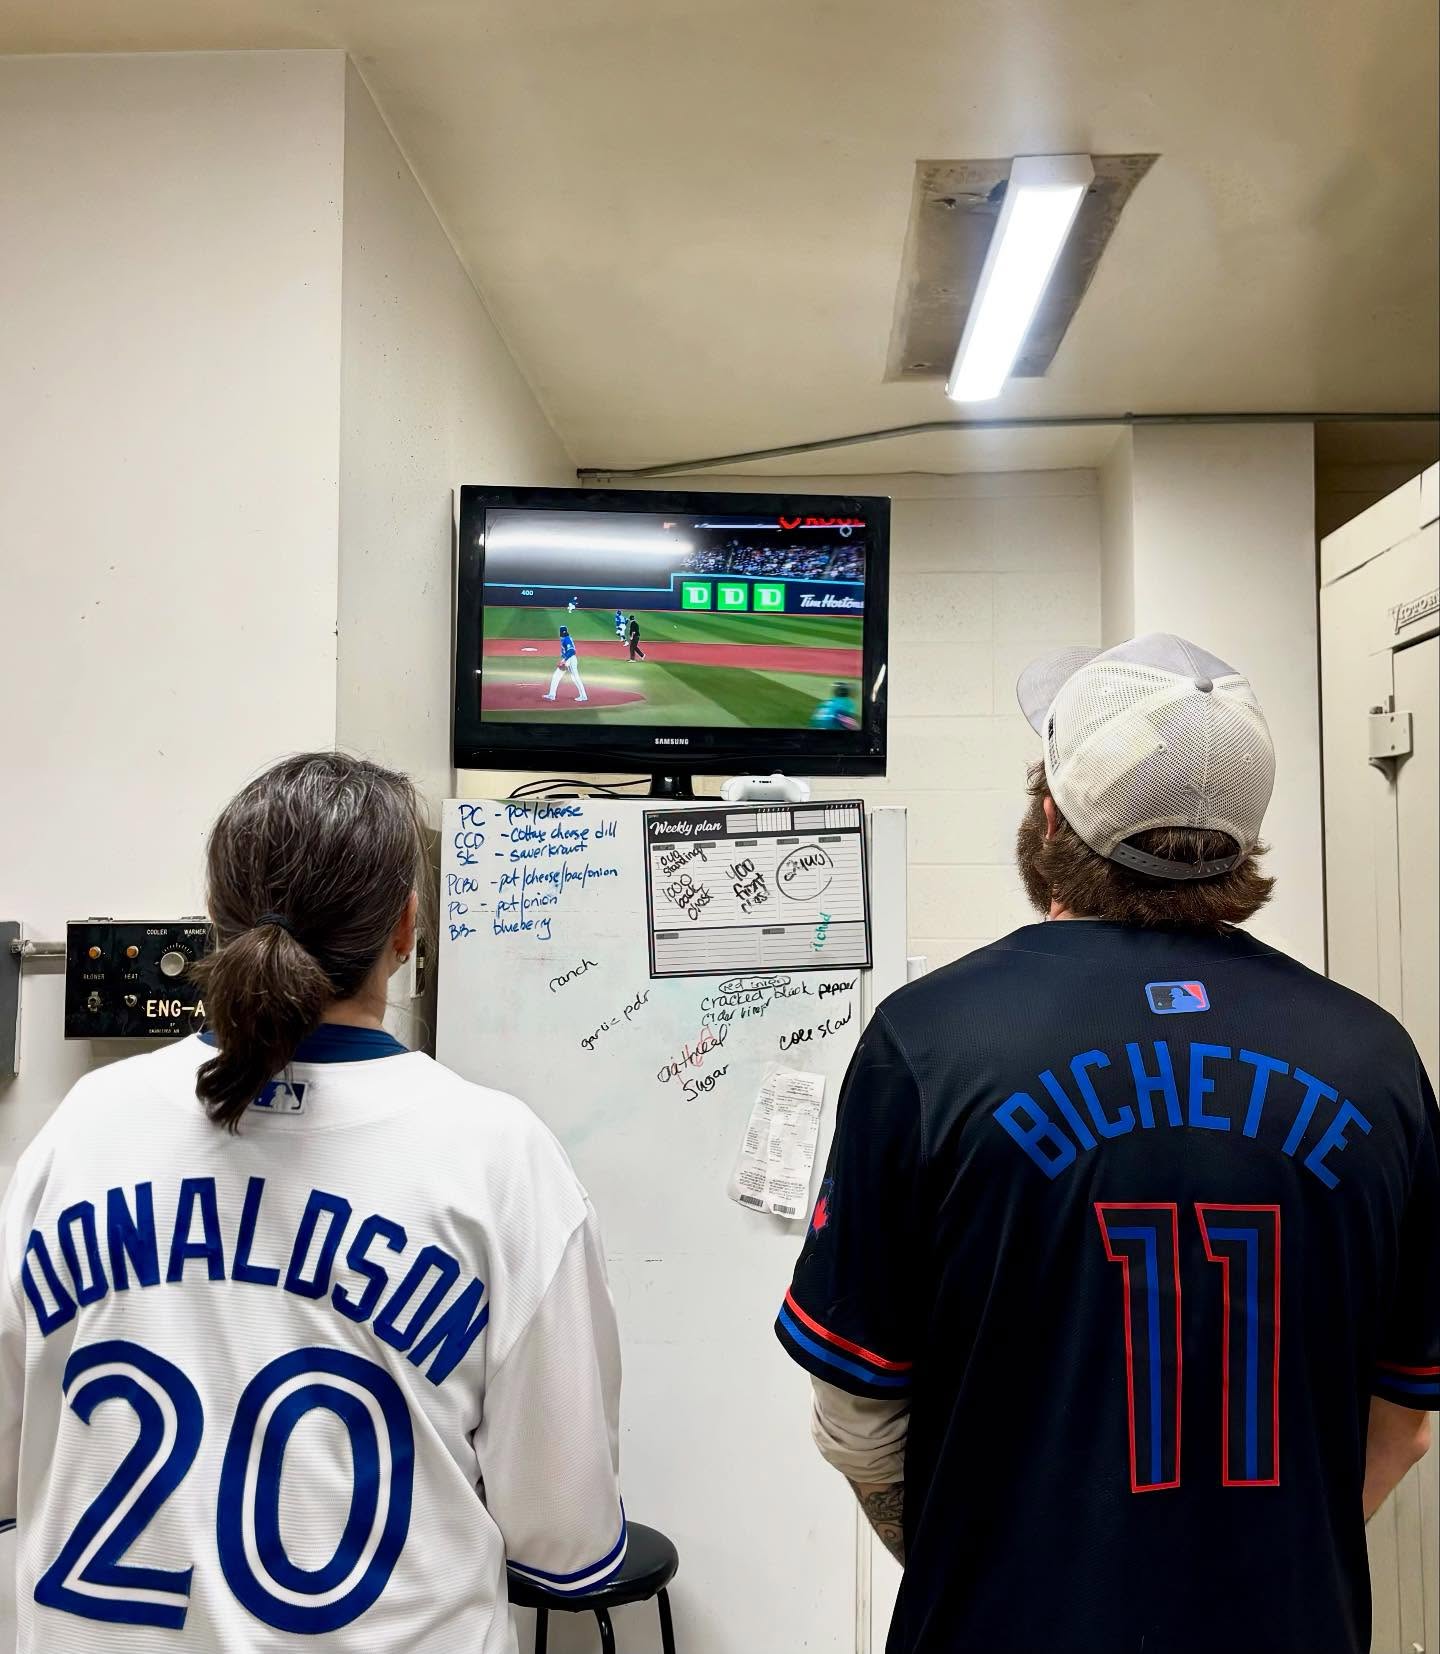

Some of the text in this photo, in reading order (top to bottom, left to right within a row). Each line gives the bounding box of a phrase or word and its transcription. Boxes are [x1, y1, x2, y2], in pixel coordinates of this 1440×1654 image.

[799, 594, 821, 608] Tim
[654, 737, 689, 745] SAMSUNG
[458, 804, 486, 830] PC
[649, 819, 722, 836] Weekly plan
[454, 832, 485, 849] CCD
[595, 820, 618, 838] dill
[445, 873, 479, 896] PCBO
[447, 901, 469, 920] PO
[549, 958, 598, 993] ranch
[992, 1040, 1373, 1191] BICHETTE
[21, 1176, 490, 1387] DONALDSON
[1093, 1202, 1281, 1493] 11
[34, 1340, 415, 1635] 20
